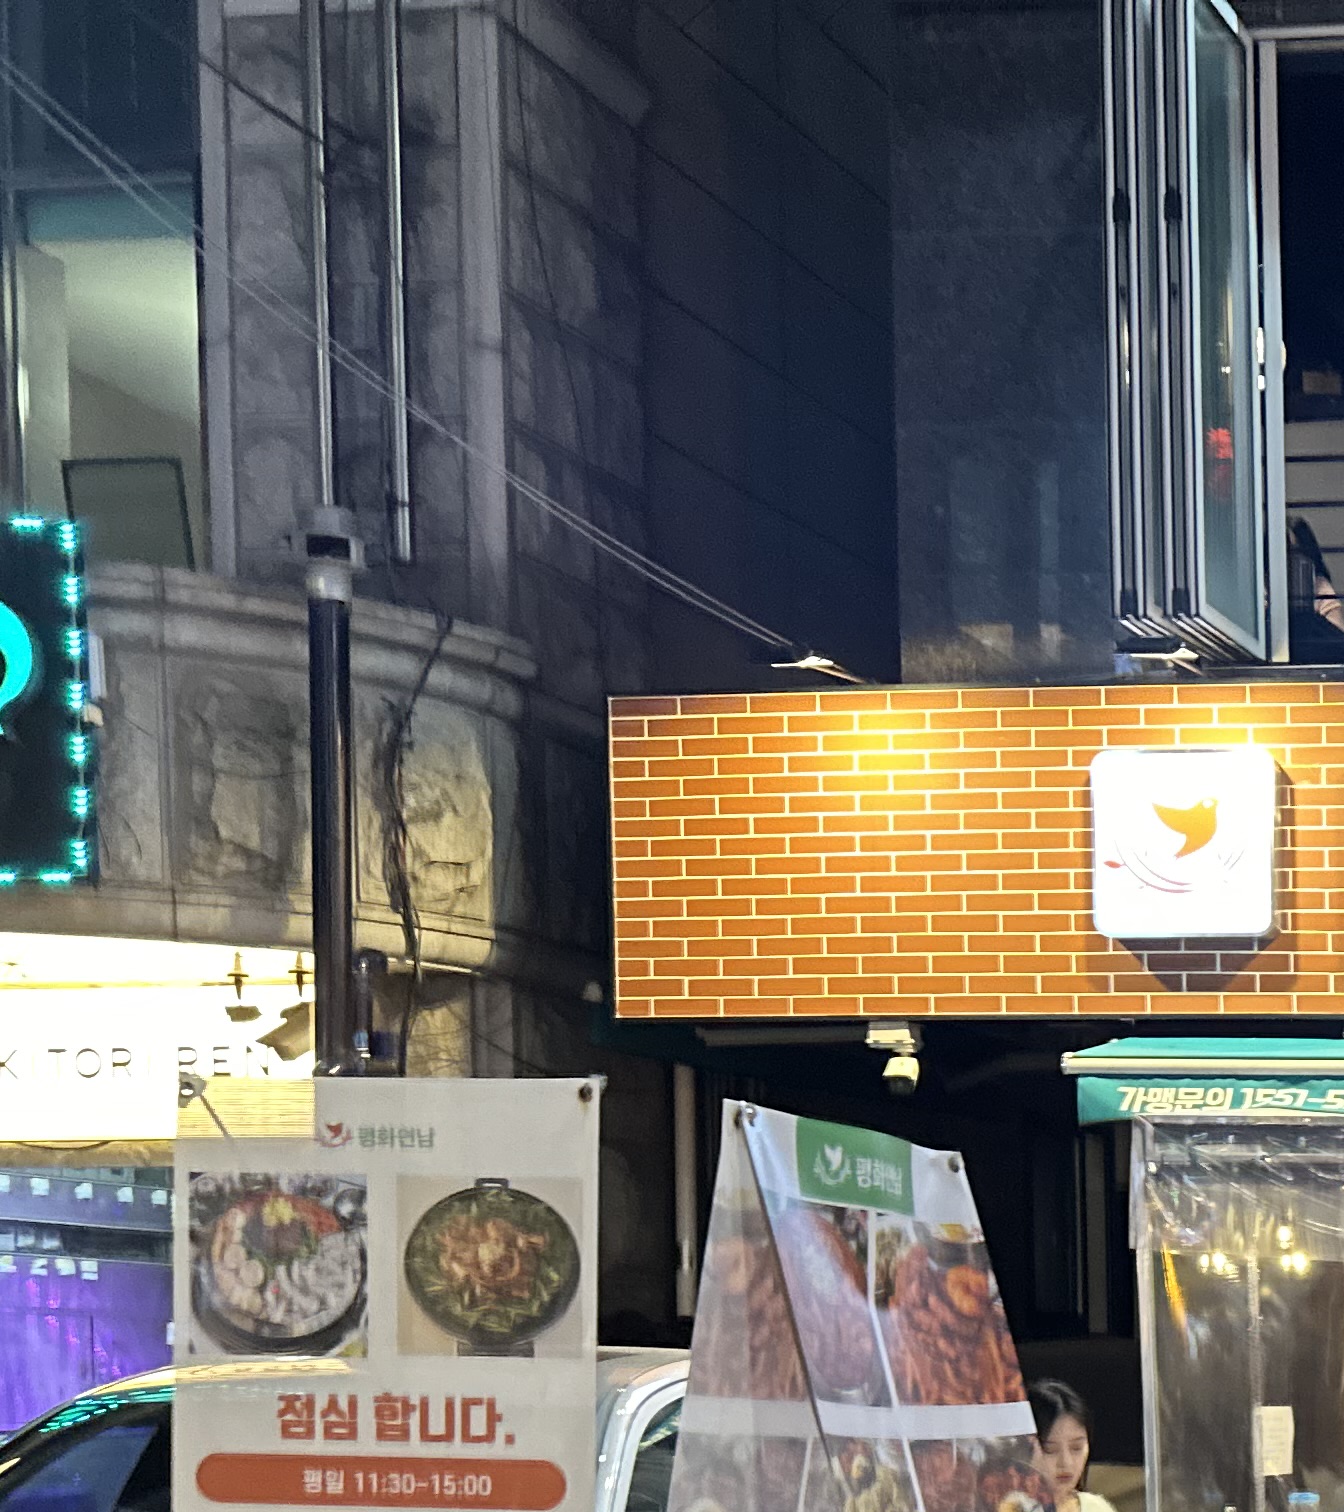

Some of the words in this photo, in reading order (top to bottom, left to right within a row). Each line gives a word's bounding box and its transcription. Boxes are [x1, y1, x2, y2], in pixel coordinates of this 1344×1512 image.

[1115, 1086, 1233, 1113] 가맹문의
[277, 1393, 358, 1440] 점심
[373, 1393, 516, 1445] 합니다.
[303, 1468, 345, 1494] 평일
[354, 1472, 493, 1497] 11:30-15:00
